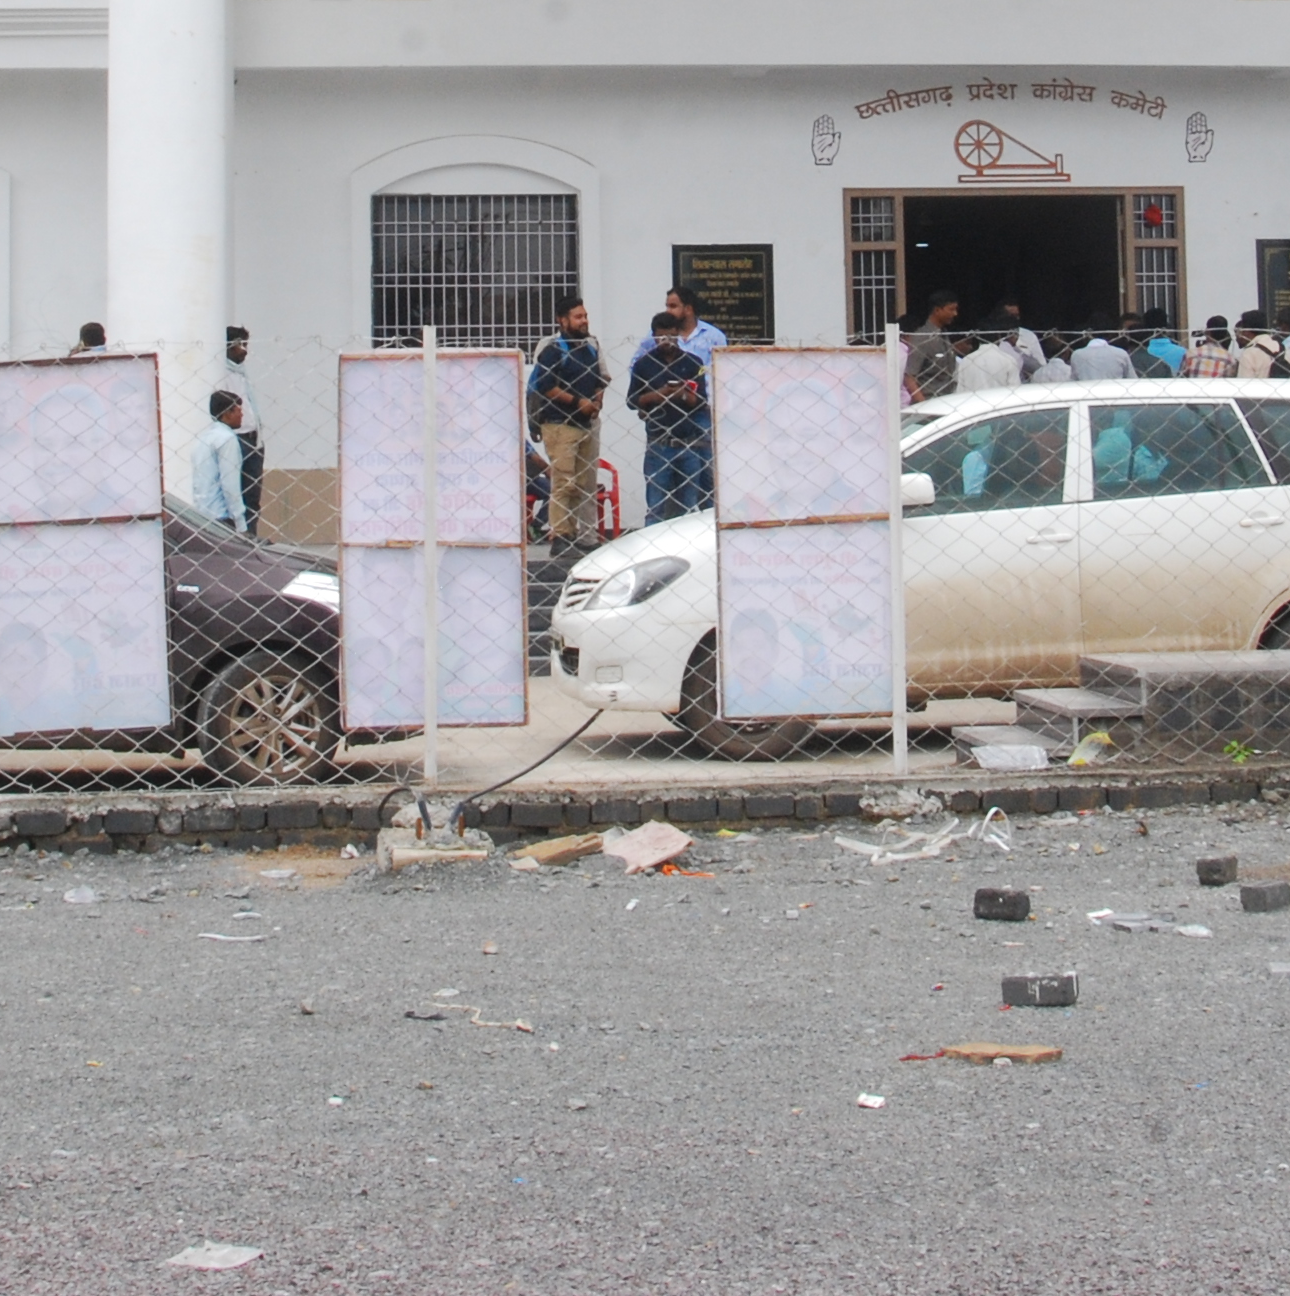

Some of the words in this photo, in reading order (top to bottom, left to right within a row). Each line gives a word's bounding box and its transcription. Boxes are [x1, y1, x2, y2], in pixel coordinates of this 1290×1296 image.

[855, 84, 953, 120] छत्तीसगढ़
[966, 77, 1017, 101] प्रदेश
[1031, 78, 1097, 103] कांग्रेस
[1110, 89, 1168, 120] कमेटी
